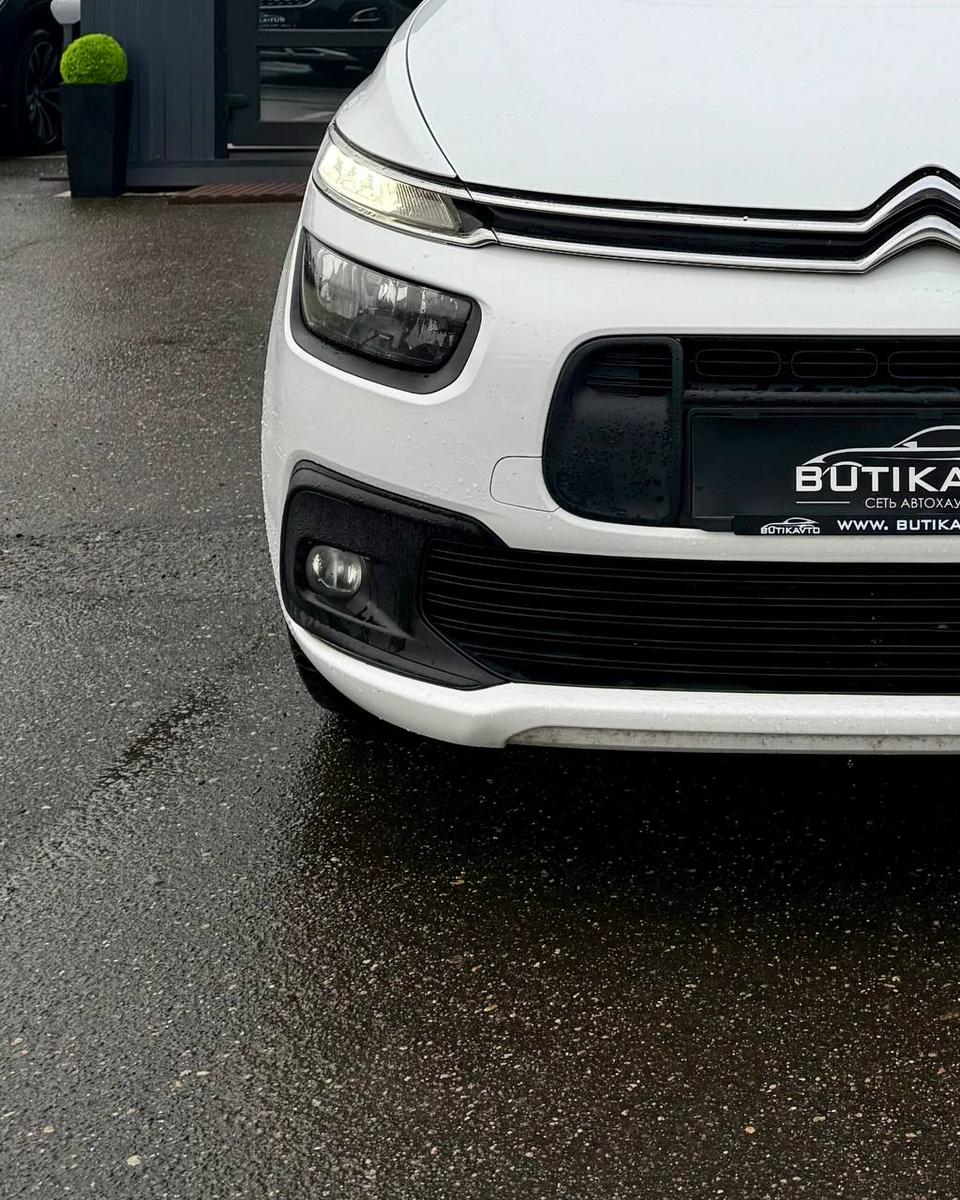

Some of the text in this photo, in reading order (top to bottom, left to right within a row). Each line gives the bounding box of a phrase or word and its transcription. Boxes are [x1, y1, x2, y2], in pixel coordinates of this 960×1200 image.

[864, 498, 897, 509] СЕТЬ
[760, 526, 820, 534] BUTIKAVTO
[837, 519, 889, 531] WWW.
